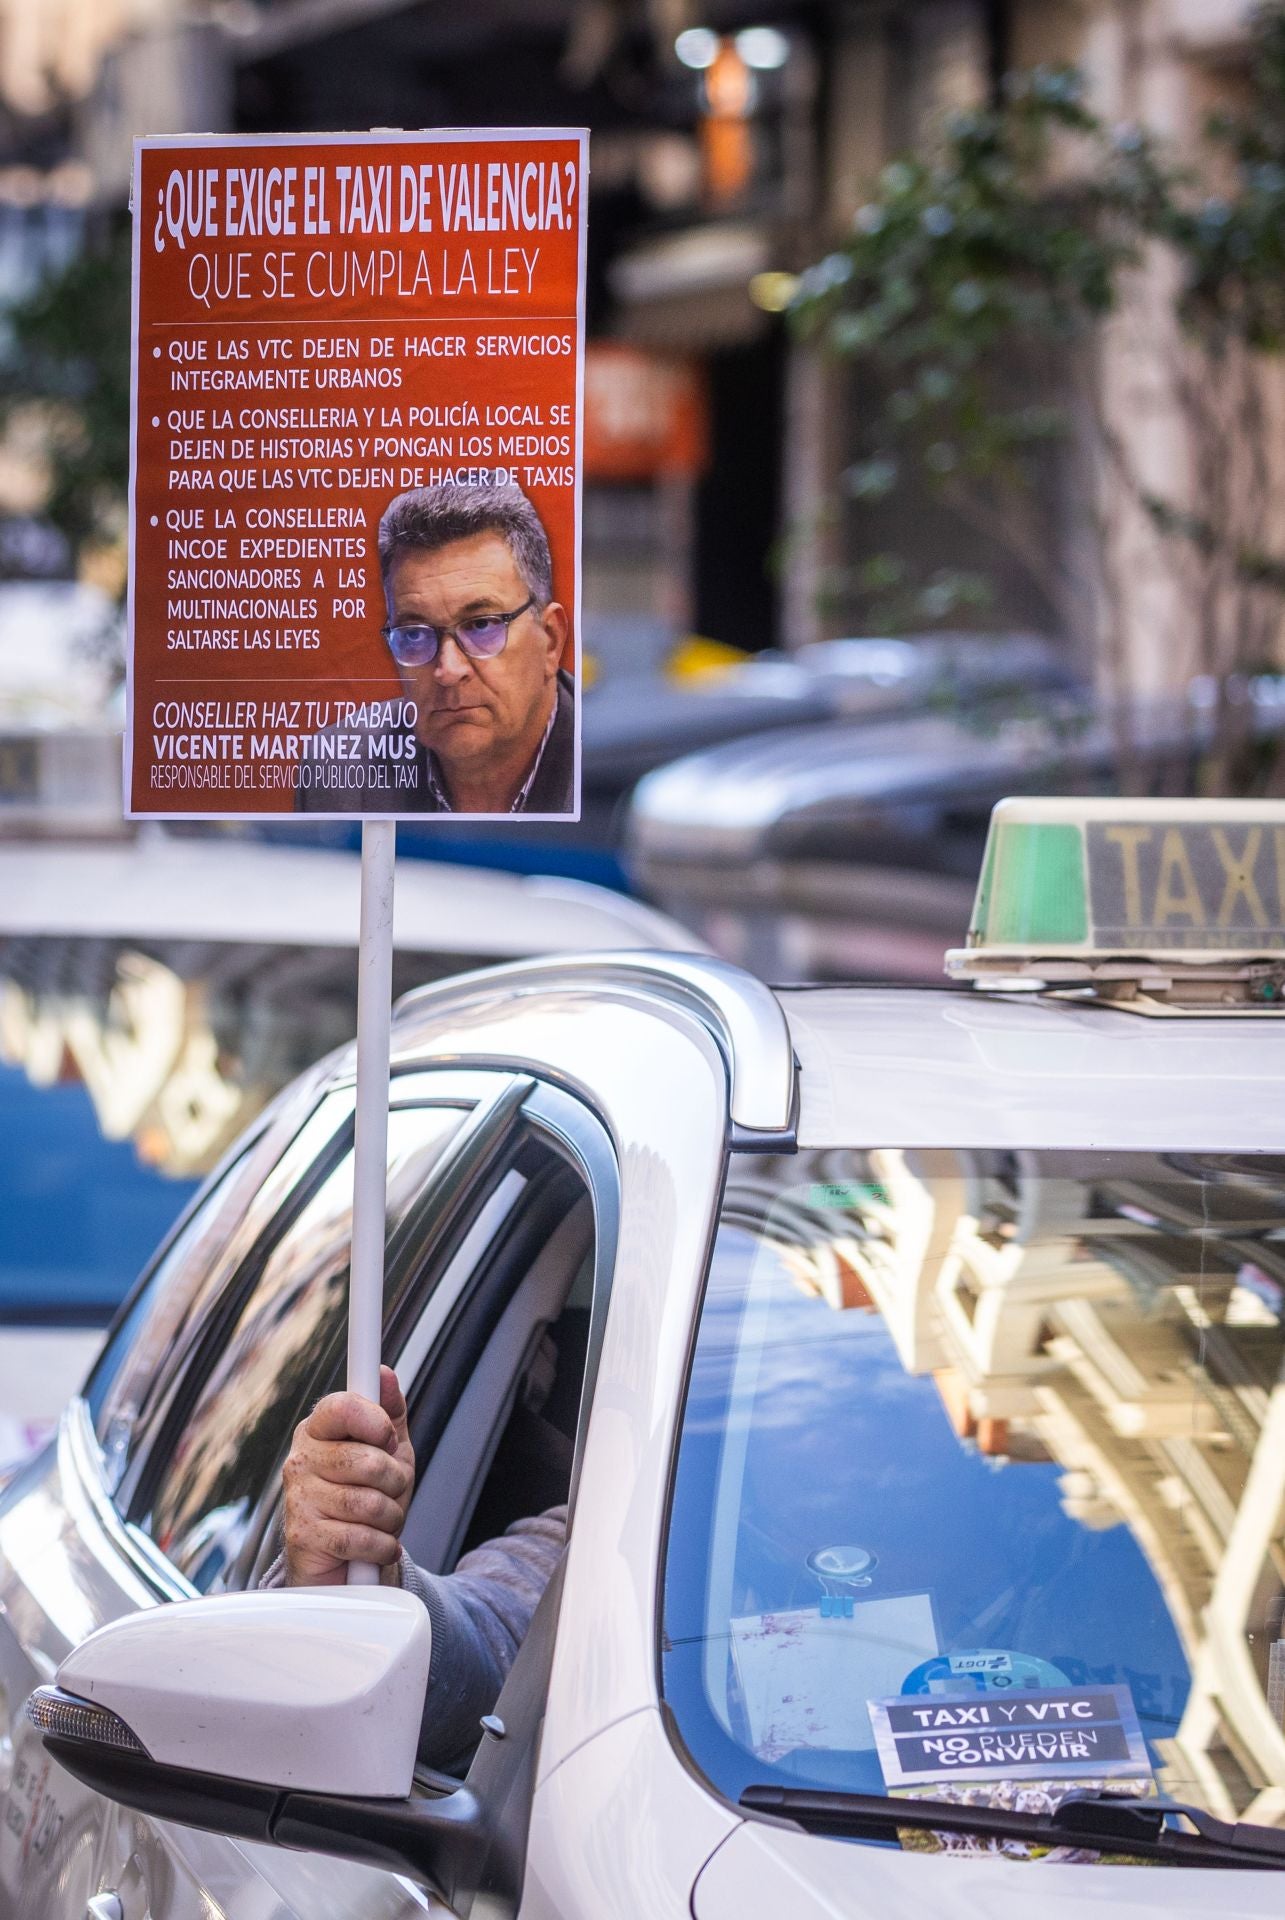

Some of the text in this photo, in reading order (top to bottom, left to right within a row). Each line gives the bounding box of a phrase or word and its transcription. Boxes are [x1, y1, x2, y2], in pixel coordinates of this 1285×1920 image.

[154, 161, 575, 253] ¿QUE EXIGE EL TAXI DE VALENCIA?
[189, 248, 539, 308] QUE SE CUMPLA LA LEY
[169, 335, 571, 363] QUE LAS VTC DEJEN DE HACER SERVICIOS
[172, 368, 402, 390] INTEGRAMENTE URBANOS
[168, 401, 570, 433] QUE LA CONSELLERIA Y LA POLICÍA LOCAL SE
[170, 436, 569, 460] DEJEN DE HISTORIAS Y PONGAN LOS MEDIOS
[169, 466, 574, 492] PARA QUE LAS VTC DEJEN DE HACER DE TAXIS
[167, 508, 366, 532] QUE LA CONSELLERIA
[169, 538, 365, 559] INCOE EXPEDIENTES
[168, 569, 365, 589] SANCIONADORES A LAS
[169, 599, 365, 619] MULTINACIONALES POR
[168, 630, 319, 649] SALTARSE LAS LEYES
[154, 702, 417, 728] CONSELLER HAZ TU TRABAJO
[153, 735, 416, 759] VICENTE MARTINEZ MUS
[151, 758, 417, 789] RESPONSABLE DEL SERVICIO PÚBLICO DEL TAXI
[955, 1660, 985, 1668] DGT
[913, 1702, 1093, 1726] TAXI Y VTC
[923, 1730, 1097, 1753] NO PUEDEN
[939, 1744, 1090, 1765] CONVIVIR
